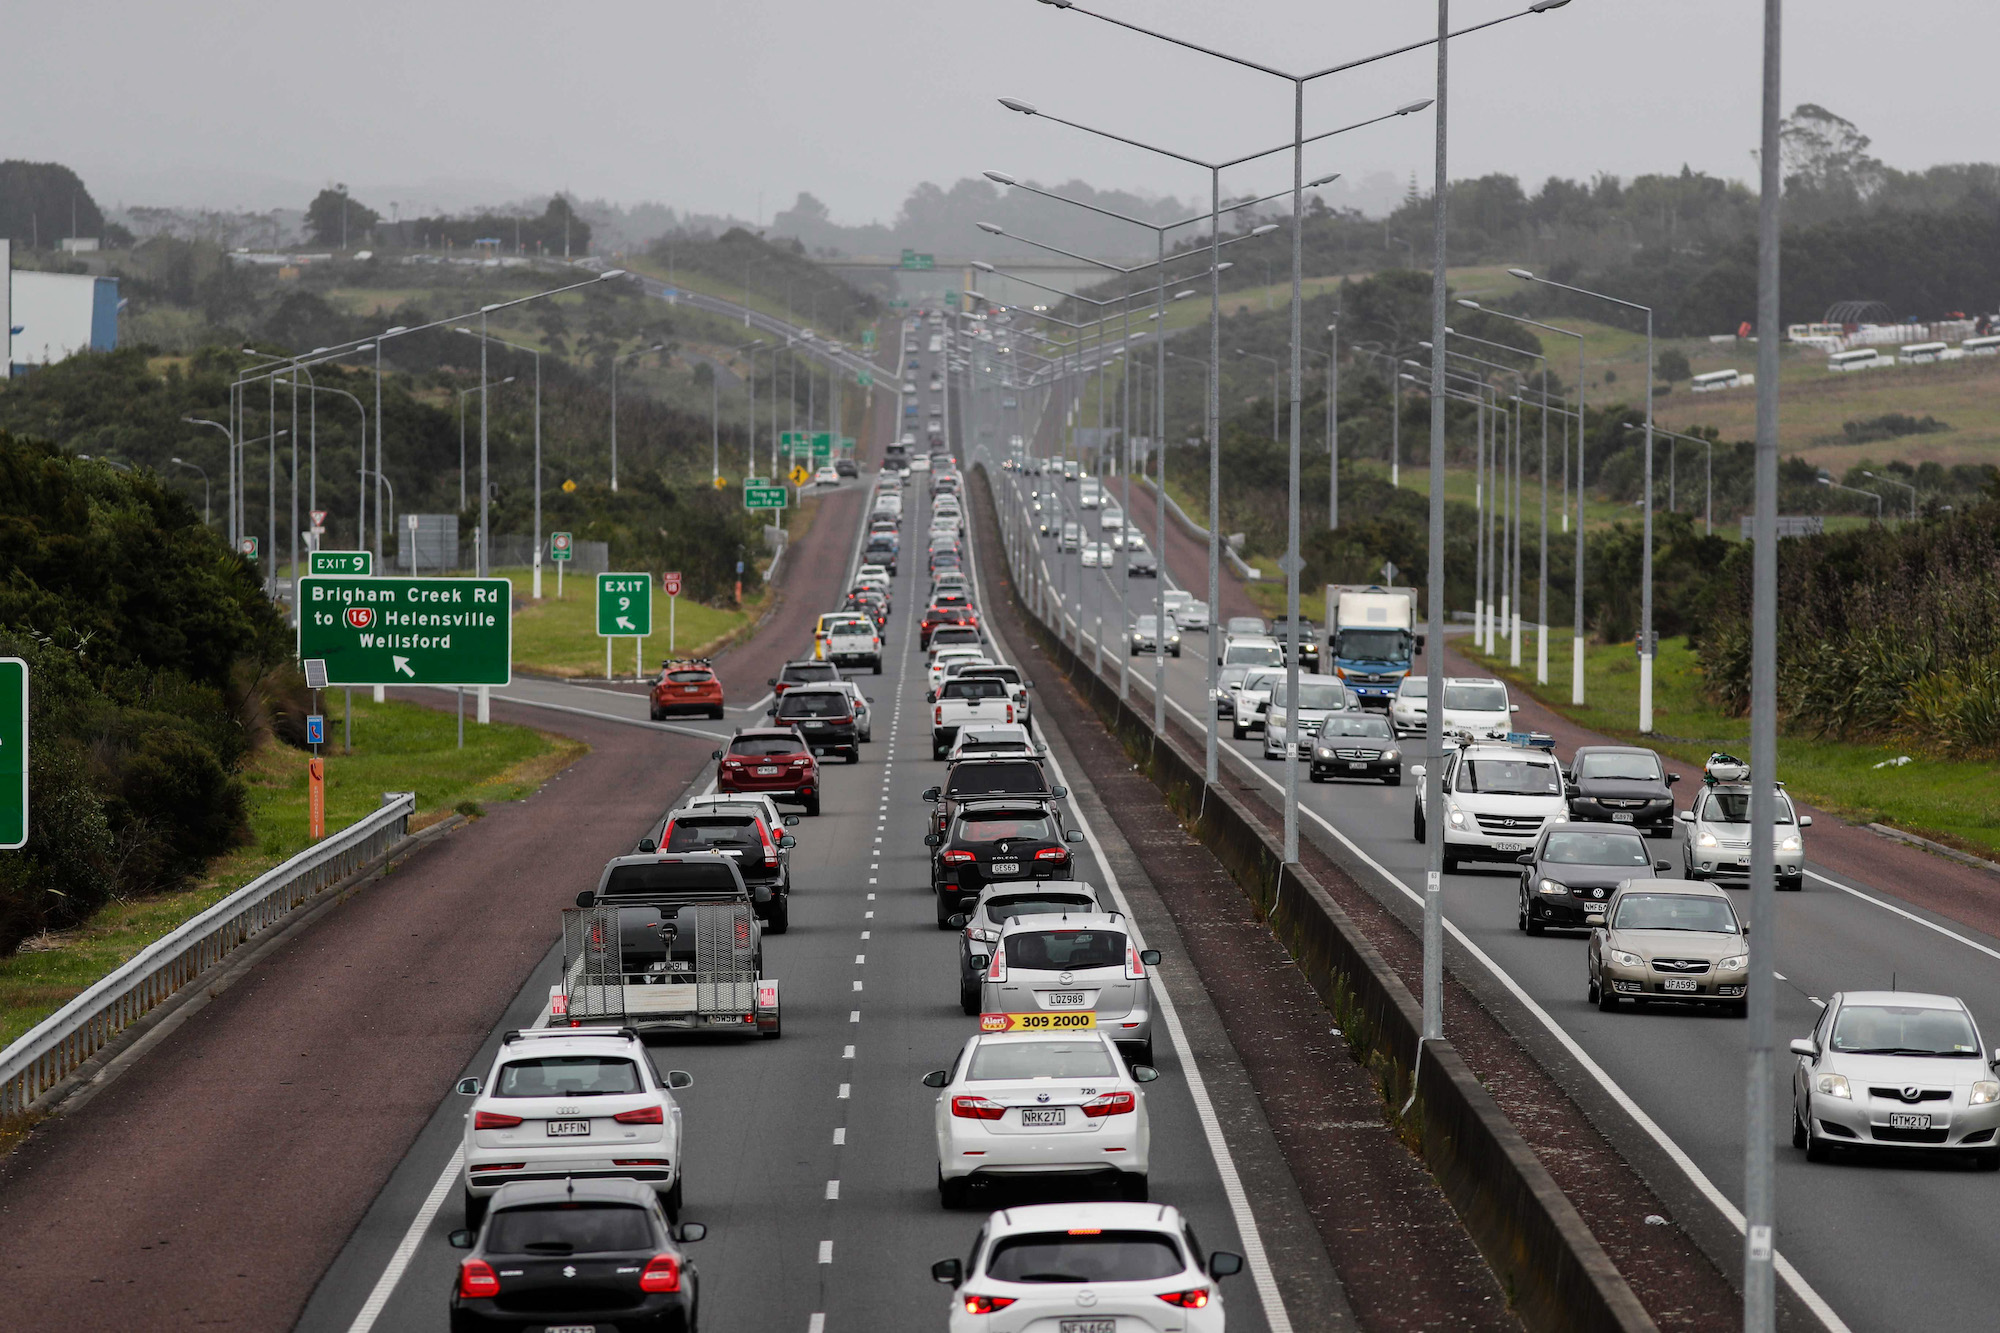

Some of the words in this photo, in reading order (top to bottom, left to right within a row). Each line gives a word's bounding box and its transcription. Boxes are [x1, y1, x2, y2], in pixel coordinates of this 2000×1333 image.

[317, 559, 347, 569] EXIT
[352, 557, 364, 571] 9
[605, 581, 643, 592] EXIT
[312, 586, 395, 605] Brigham
[407, 587, 462, 603] Creek
[474, 588, 498, 603] Rd
[618, 597, 630, 611] 9
[314, 610, 334, 626] to
[385, 611, 496, 627] Helensville
[359, 633, 451, 649] Wellsford
[1665, 981, 1696, 989] JFA595
[1050, 995, 1083, 1004] LQZ989
[983, 1016, 1005, 1025] Alert
[1022, 1016, 1049, 1027] 309
[1053, 1015, 1089, 1027] 2000
[1024, 1112, 1062, 1122] NRK271
[1892, 1115, 1929, 1127] HTM217
[550, 1122, 587, 1133] LAFFIN
